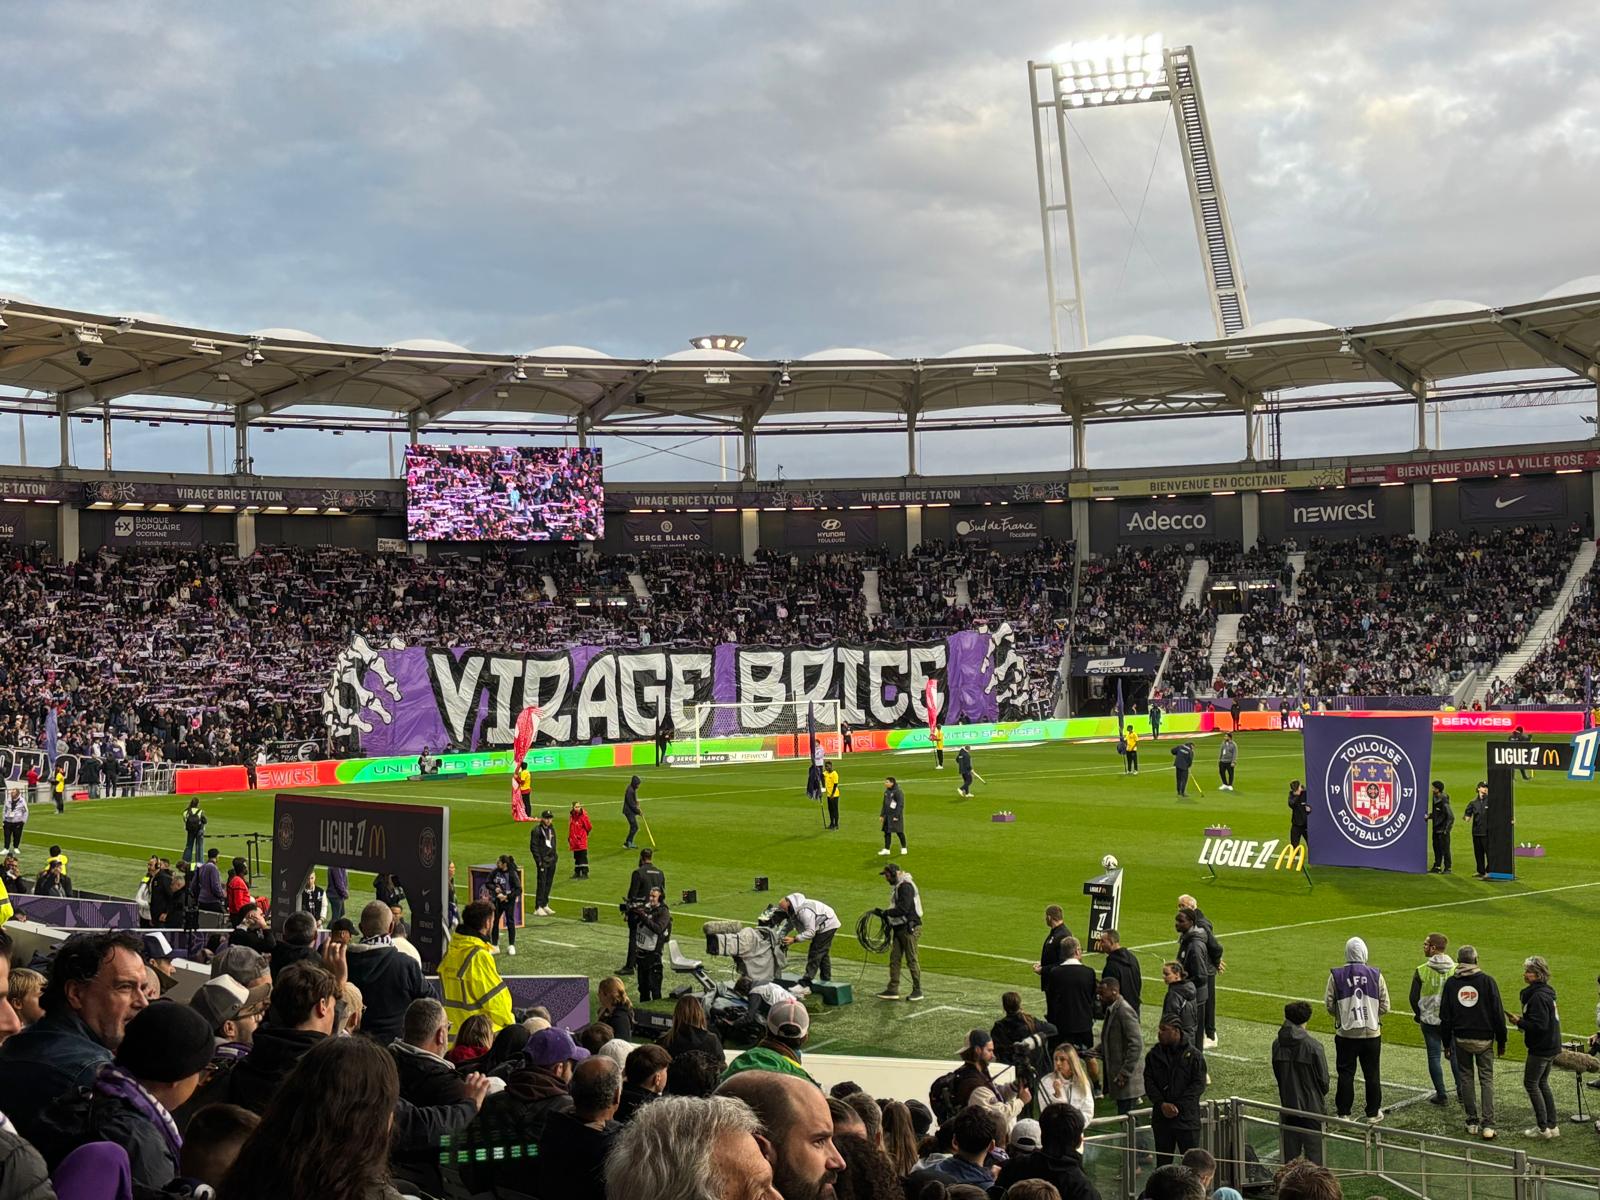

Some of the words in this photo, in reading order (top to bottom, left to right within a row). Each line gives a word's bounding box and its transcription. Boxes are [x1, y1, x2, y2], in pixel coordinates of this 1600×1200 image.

[1397, 462, 1461, 477] BIENVENUE
[1464, 460, 1496, 473] DANS
[1499, 459, 1514, 471] LA
[1517, 456, 1550, 469] VILLE
[1553, 454, 1588, 466] ROSE.
[12, 483, 46, 496] TATON
[1150, 478, 1210, 492] BIENVENUE
[1213, 476, 1227, 489] EN
[1230, 474, 1291, 488] OCCITANIE.
[177, 487, 214, 500] VIRAGE
[217, 488, 247, 500] BRICE
[249, 489, 283, 501] TATON
[634, 495, 670, 506] VIRAGE
[672, 495, 700, 505] BRICE
[702, 495, 734, 505] TATON
[861, 491, 897, 502] VIRAGE
[899, 490, 927, 501] BRICE
[929, 489, 961, 500] TATON
[135, 516, 169, 524] BANQUE
[135, 523, 181, 531] POPULAIRE
[969, 518, 988, 533] Sud
[988, 521, 1000, 530] de
[1000, 516, 1037, 532] France
[1126, 510, 1207, 531] Adecco
[634, 534, 662, 542] SERGE
[665, 533, 701, 541] BLANCO
[431, 650, 714, 744] VIRAGE
[737, 643, 947, 732] BRICE
[1441, 717, 1512, 727] SERVICES
[1340, 741, 1402, 766] TOULOUSE
[1494, 747, 1529, 765] LIGUE
[1330, 785, 1341, 794] 19
[1402, 788, 1414, 797] 37
[1338, 809, 1384, 841] FOOTBALL
[1384, 812, 1407, 838] CLUB
[319, 818, 354, 856] LIGUE
[1198, 837, 1258, 869] LIGUE
